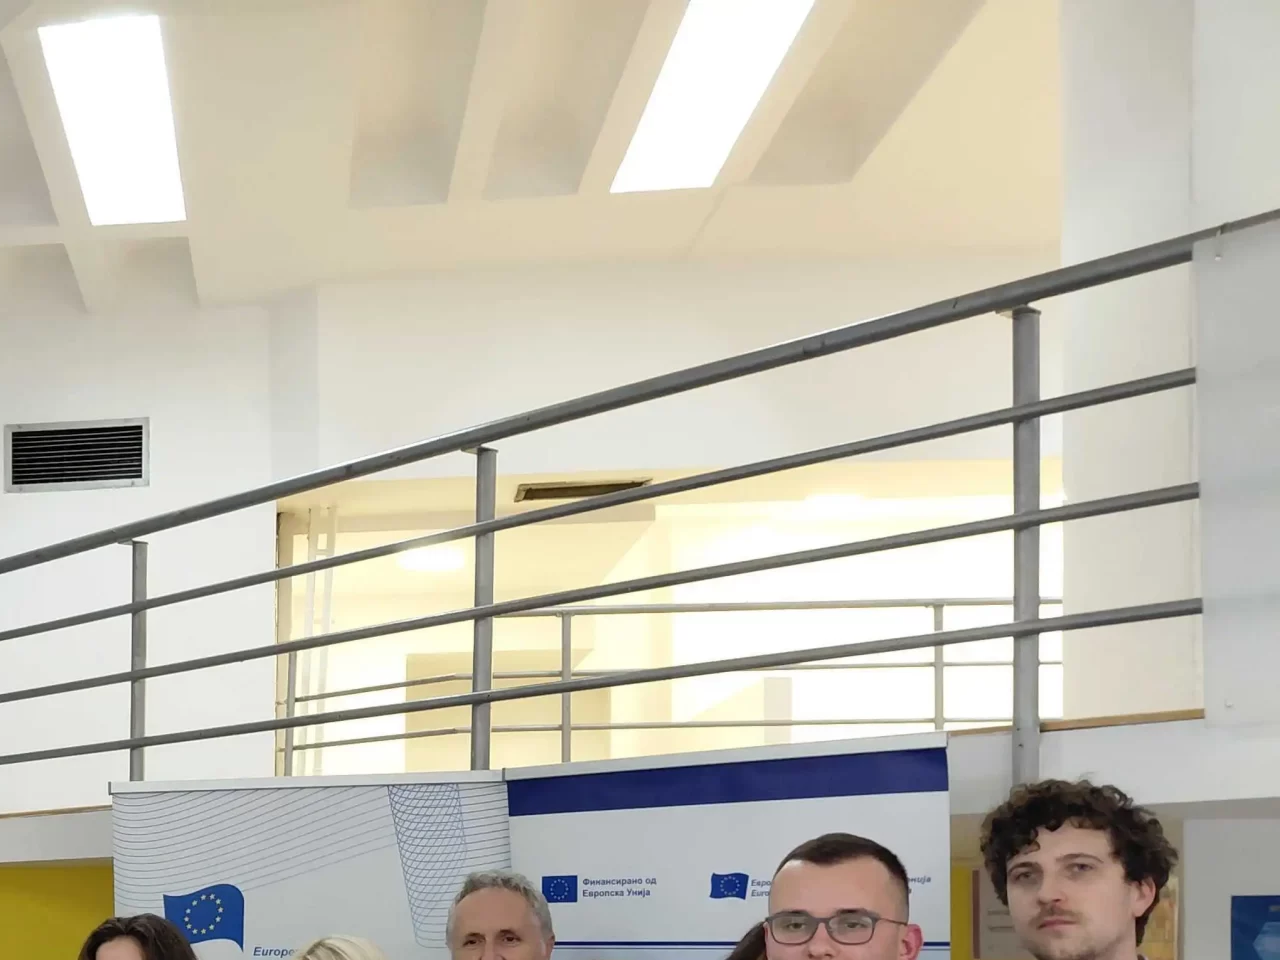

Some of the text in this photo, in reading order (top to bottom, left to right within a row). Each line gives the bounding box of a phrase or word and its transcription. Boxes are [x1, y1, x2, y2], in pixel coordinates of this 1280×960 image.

[582, 877, 657, 887] Финансирано од
[751, 878, 772, 888] Евро
[582, 888, 651, 899] Европска Унија
[751, 889, 770, 897] Euro
[253, 946, 297, 959] Europe
